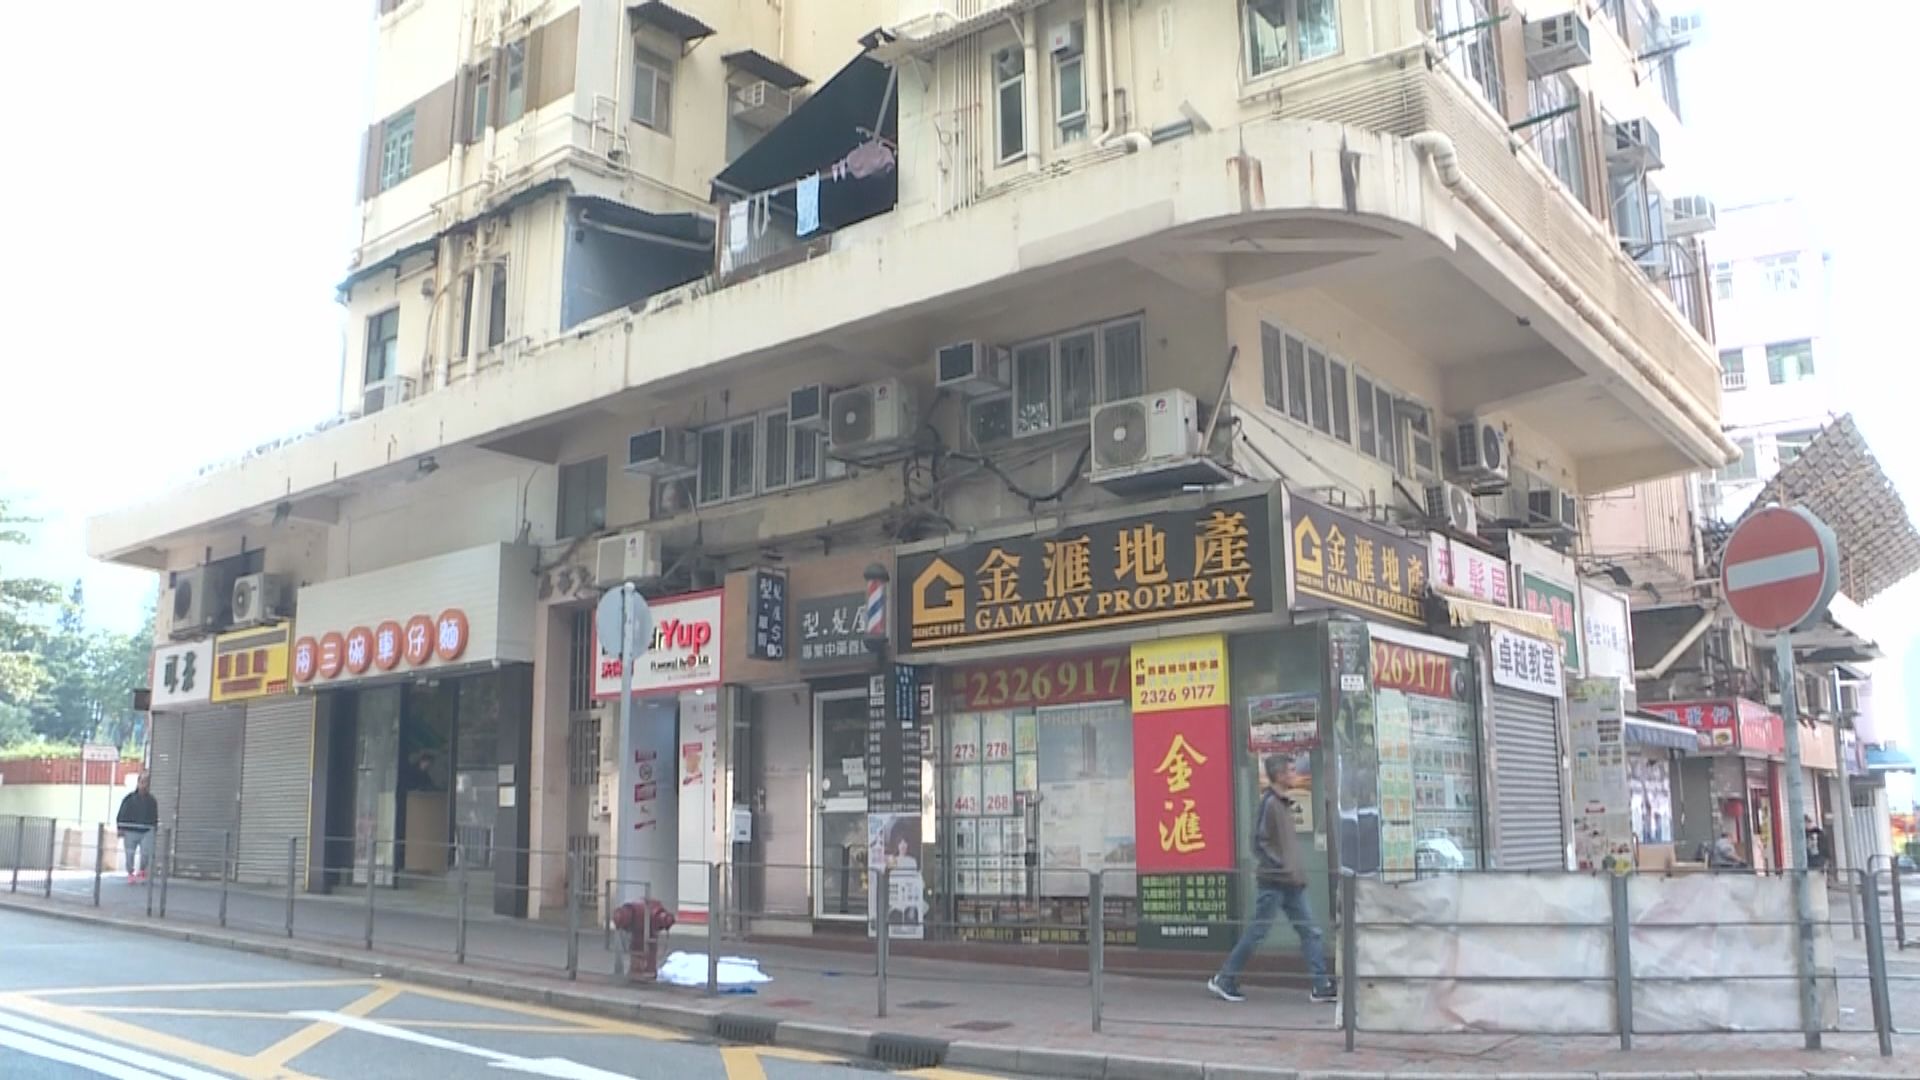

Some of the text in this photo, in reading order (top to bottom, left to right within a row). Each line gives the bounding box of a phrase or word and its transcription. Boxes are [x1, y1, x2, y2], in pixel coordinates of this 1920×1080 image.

[975, 595, 1089, 631] GAMWAY
[1096, 573, 1252, 616] PROPERTY
[1327, 571, 1376, 607] GAMWAY
[295, 617, 459, 674] 兩三碗車仔麵
[1500, 633, 1557, 686] 卓越教室
[968, 656, 1129, 706] 2326917
[1140, 683, 1215, 705] 2326 9177
[954, 743, 976, 759] 273
[986, 742, 1008, 757] 278
